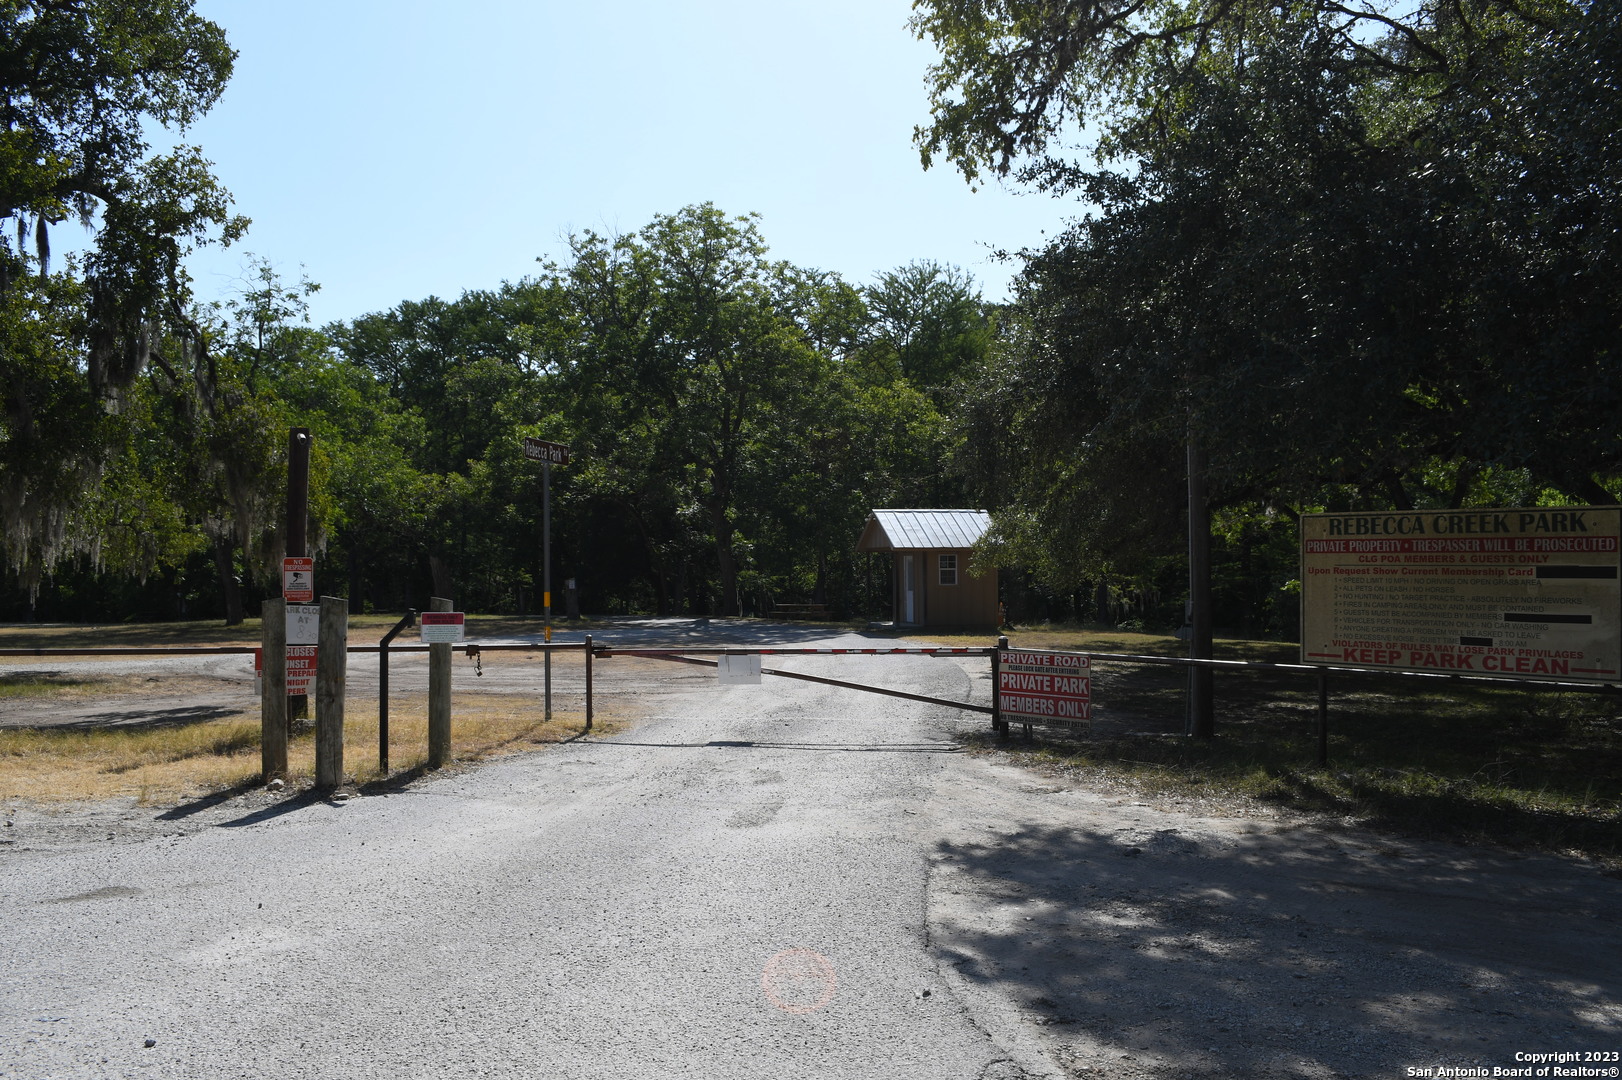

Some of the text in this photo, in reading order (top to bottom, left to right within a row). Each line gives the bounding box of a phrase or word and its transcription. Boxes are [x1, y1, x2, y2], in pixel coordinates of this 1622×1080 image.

[549, 445, 562, 462] Park
[1329, 512, 1588, 535] REBECCA CREEK PARK
[1307, 538, 1615, 552] PRIVATE PROPERTY TRESPASSER WILL BE PROSECUTED
[1358, 555, 1550, 563] CLG POA MEMBERS & GUESTS ONLY
[1308, 567, 1330, 576] Upon
[1333, 567, 1370, 576] Request
[1401, 567, 1438, 575] Current
[1442, 568, 1504, 577] Membership
[1508, 568, 1533, 576] Card
[298, 616, 309, 624] AT
[1466, 612, 1503, 620] MEMBERS
[1392, 618, 1454, 627] TRANSPORTATION
[1478, 630, 1503, 638] ASKED
[286, 648, 315, 656] CLOSES
[1332, 640, 1382, 649] VIOLATORS
[1401, 643, 1431, 651] RULES
[1434, 644, 1455, 652] MAY
[1458, 646, 1484, 655] LOSE
[1488, 647, 1515, 656] PARK
[1519, 649, 1584, 659] PRIVILAGES
[286, 660, 309, 668] NSET
[1001, 653, 1088, 667] PRIVATE ROAD
[1343, 648, 1568, 675] KEEP PARK CLEAN
[1001, 673, 1088, 694] PRIVATE PARK
[1001, 696, 1089, 718] MEMBERS ONLY
